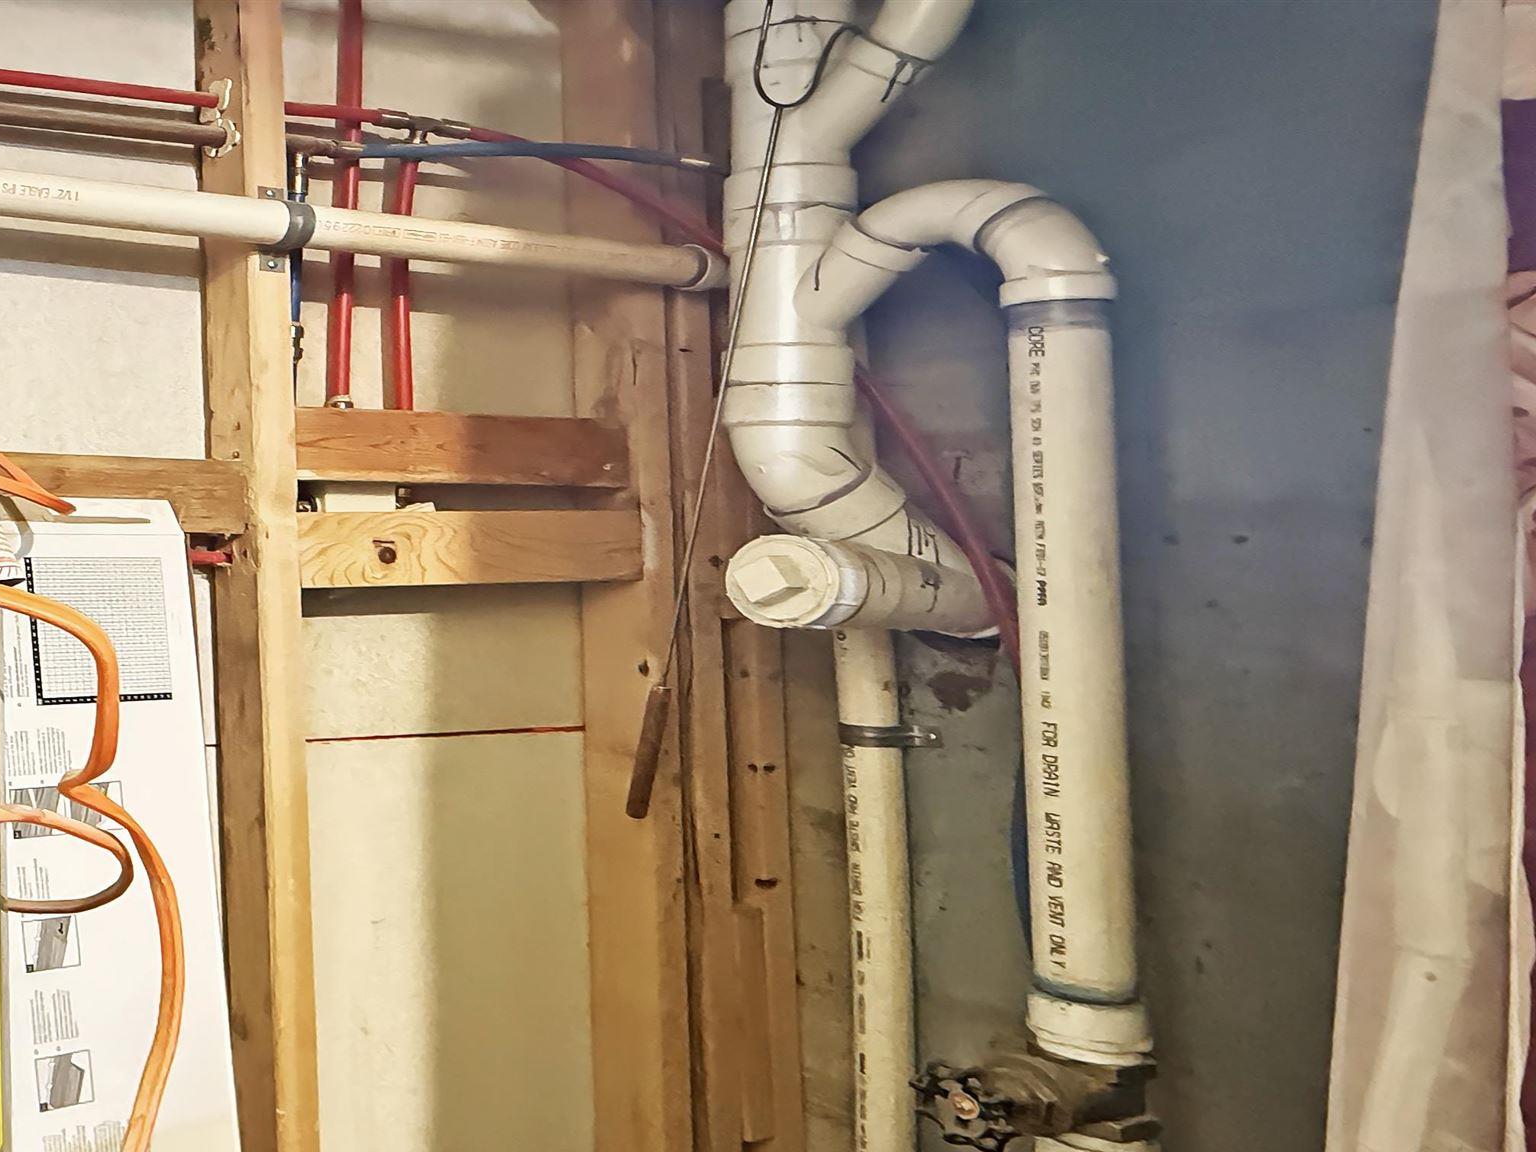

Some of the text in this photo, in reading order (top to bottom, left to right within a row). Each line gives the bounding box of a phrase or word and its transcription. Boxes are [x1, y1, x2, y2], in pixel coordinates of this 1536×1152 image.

[18, 184, 51, 200] EAGLE
[1027, 326, 1045, 357] CORE
[1040, 722, 1058, 747] FOR
[1041, 755, 1061, 797] DRAIN
[1043, 813, 1062, 854] WASTE
[1046, 861, 1065, 888] AND
[1047, 895, 1066, 927] VENT
[1049, 934, 1067, 969] ONLY
